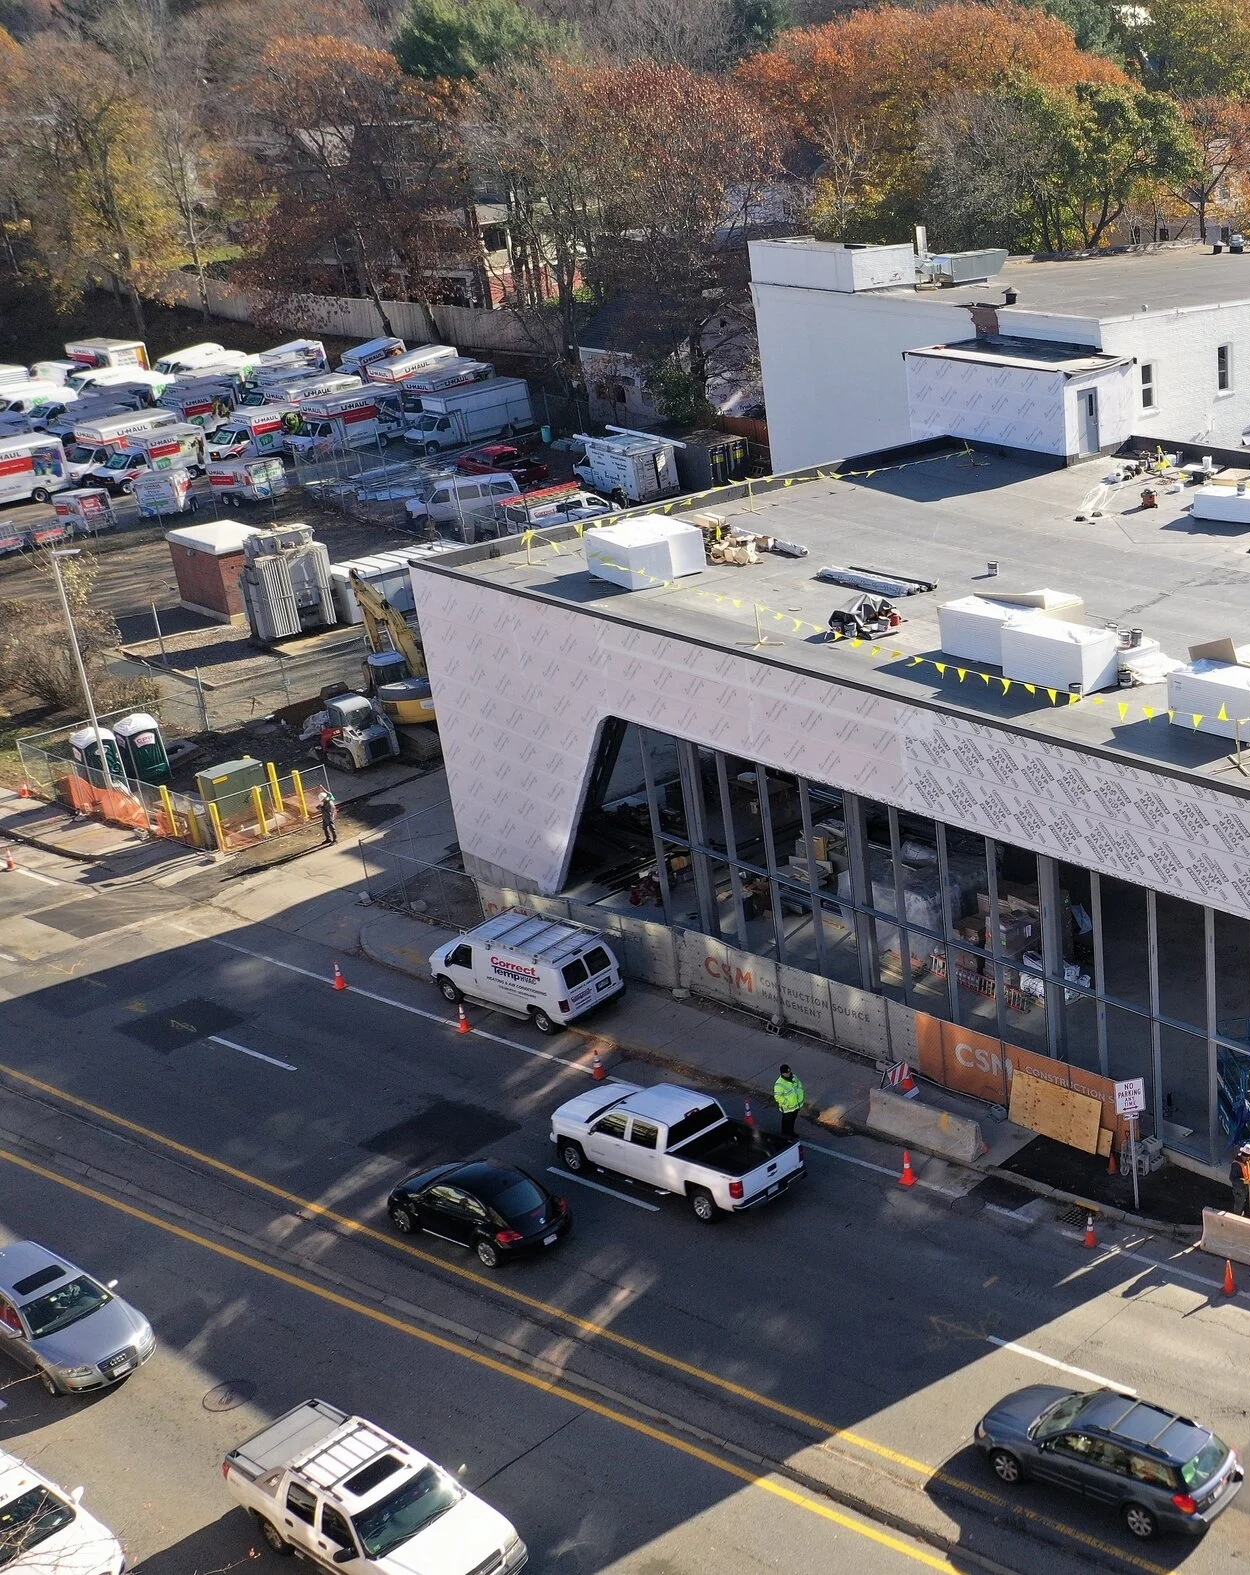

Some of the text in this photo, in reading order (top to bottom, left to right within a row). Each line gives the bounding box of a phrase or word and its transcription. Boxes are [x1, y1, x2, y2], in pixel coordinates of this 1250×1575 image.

[363, 352, 384, 364] U-HAUL
[405, 362, 430, 373] U-HAUL
[444, 376, 468, 386] U-HAUL
[304, 388, 331, 398] U-HAUL
[185, 398, 210, 406] U-HAUL
[340, 400, 370, 410] U-HAUL
[254, 415, 278, 424] U-HAUL
[117, 425, 148, 436] U-HAUL
[150, 437, 177, 447] U-HAUL
[490, 956, 536, 976] Correct
[704, 956, 753, 993] CSM
[760, 978, 871, 1022] CONSTRUCTION SOURCE
[761, 990, 823, 1020] MANAGEMENT
[955, 1042, 1013, 1080] CSM
[1026, 1066, 1105, 1100] CONSTRUCTION
[1118, 1089, 1141, 1098] PARKING
